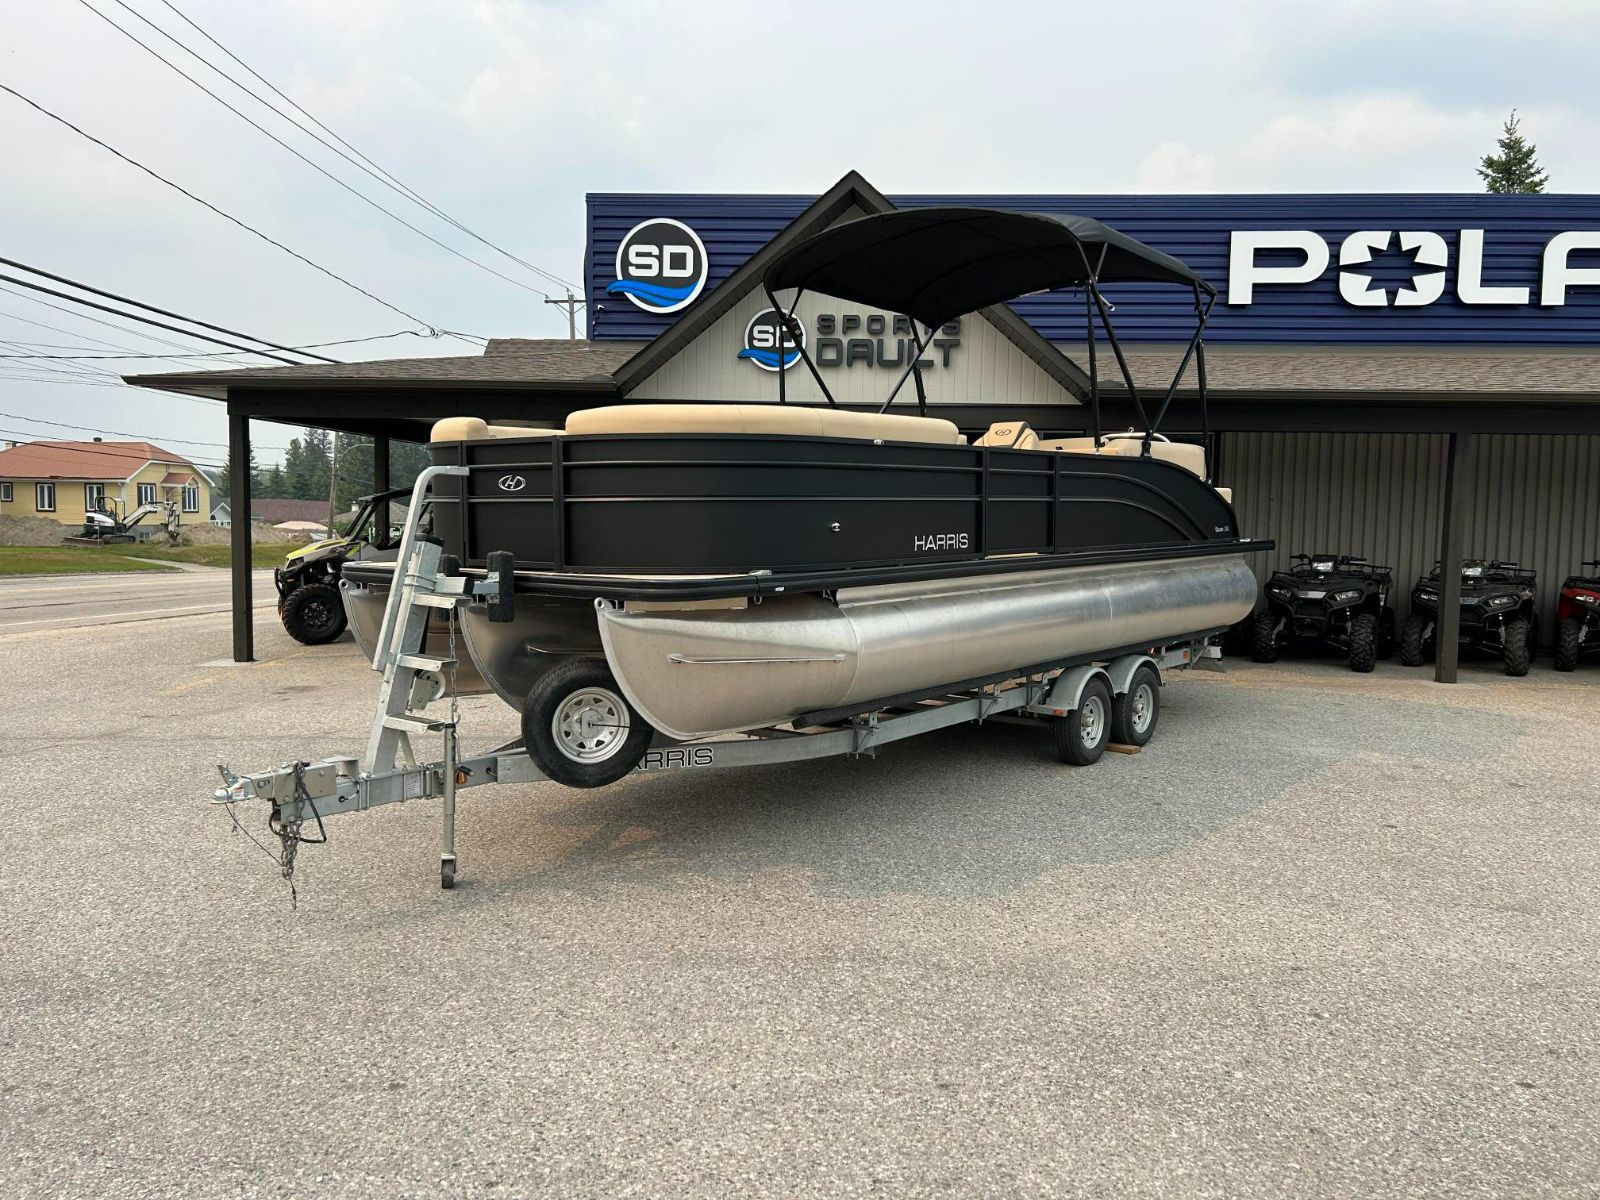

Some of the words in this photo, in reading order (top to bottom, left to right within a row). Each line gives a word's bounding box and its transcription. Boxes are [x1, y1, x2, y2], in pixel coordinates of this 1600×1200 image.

[628, 244, 694, 278] SD
[816, 313, 960, 335] SPORS
[816, 337, 961, 368] DAULT
[914, 533, 969, 551] HARRIS
[637, 747, 714, 771] RRIS
